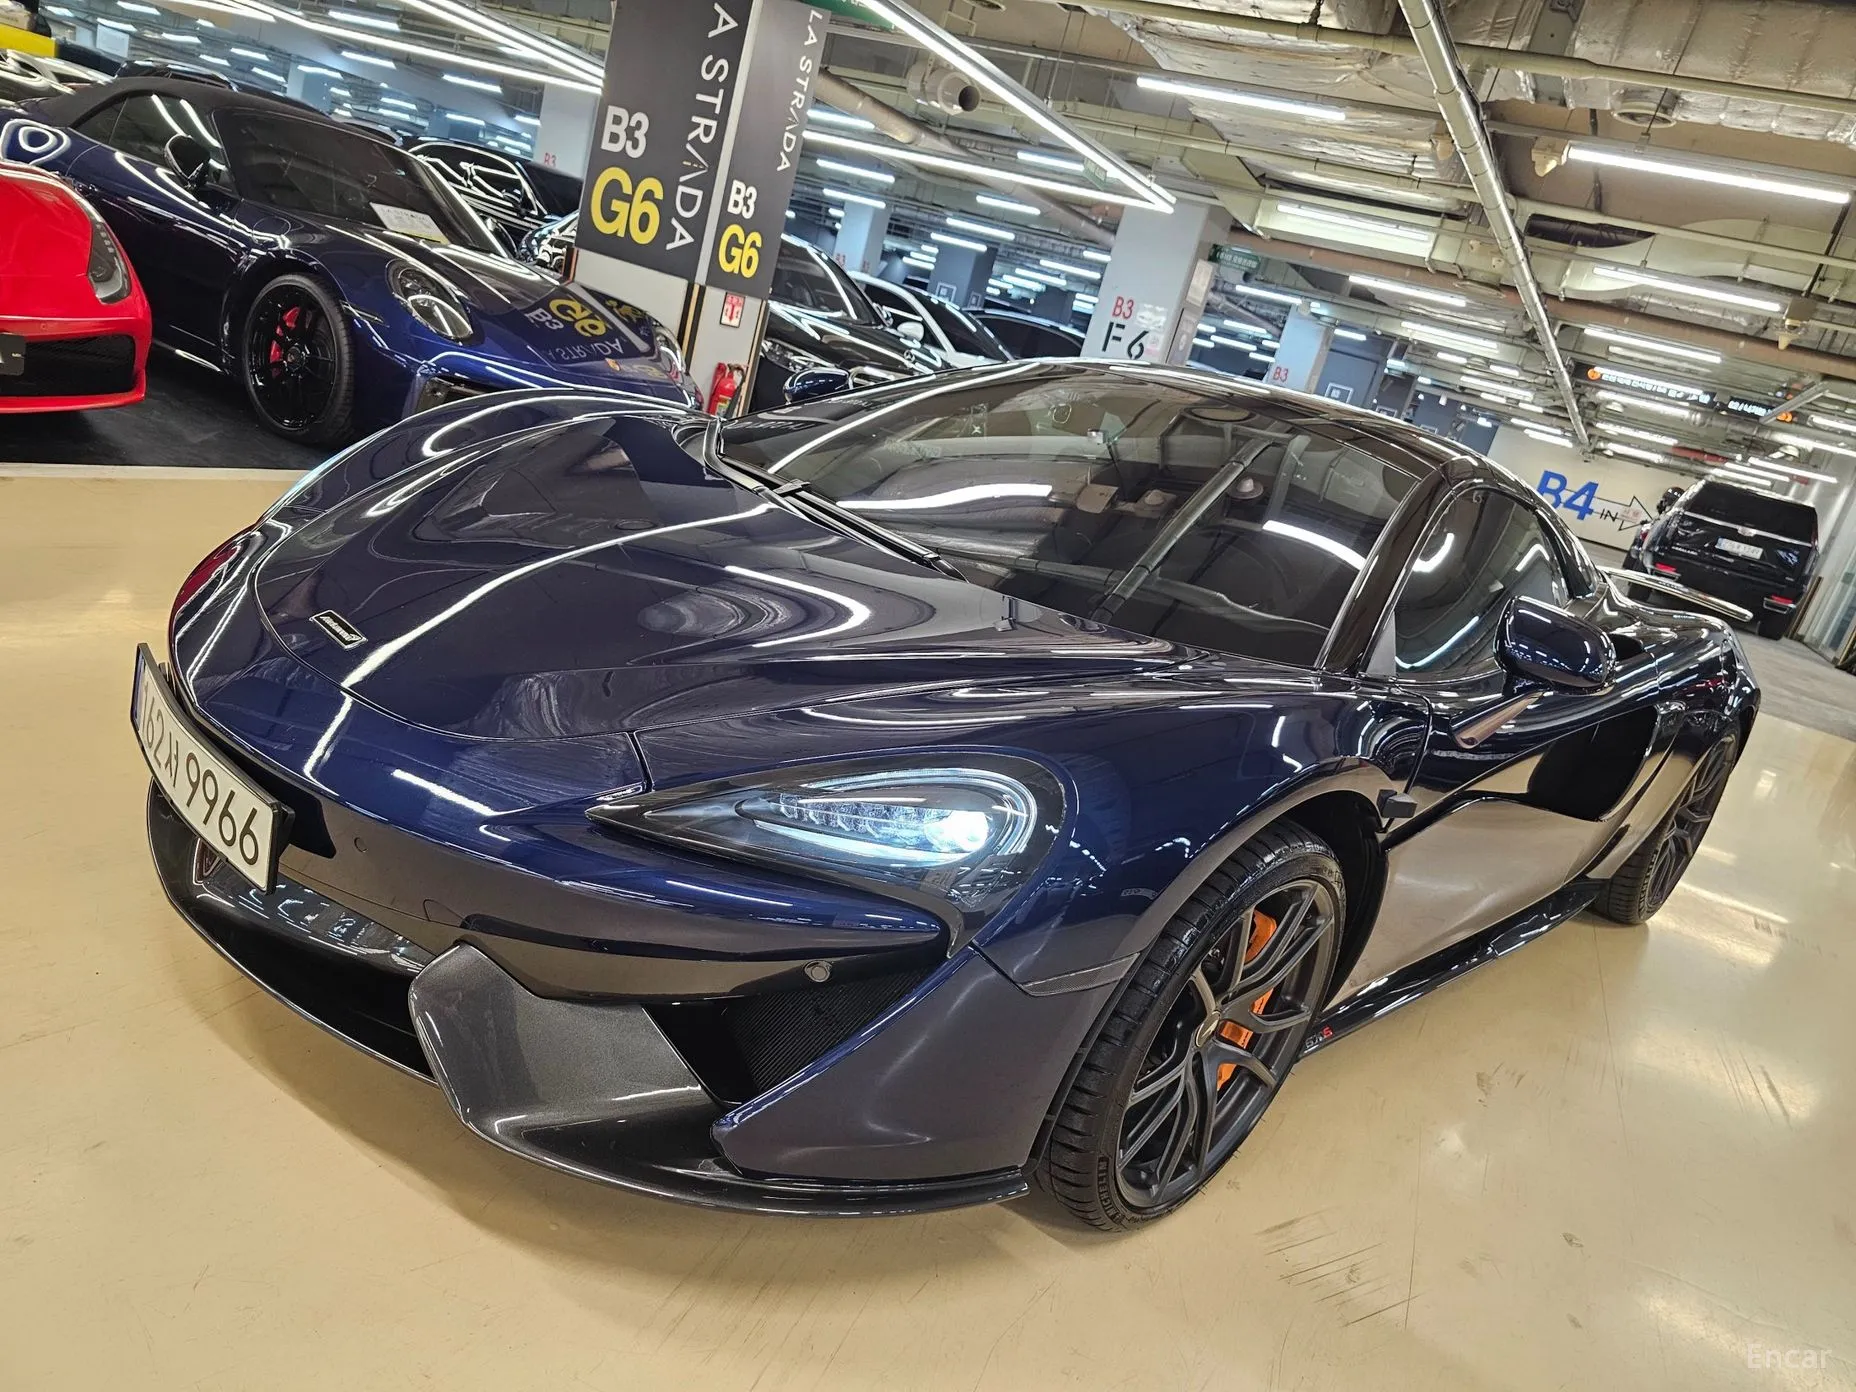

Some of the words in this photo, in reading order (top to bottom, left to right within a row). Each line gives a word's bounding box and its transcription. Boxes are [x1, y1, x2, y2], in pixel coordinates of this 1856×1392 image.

[804, 9, 823, 45] LA
[600, 105, 650, 159] B3
[776, 55, 812, 171] STRADA
[666, 54, 729, 250] STRADA
[591, 166, 664, 245] G6
[727, 179, 757, 219] B3
[718, 224, 762, 278] G6
[1112, 296, 1134, 319] B3
[1273, 366, 1289, 382] B3
[1536, 470, 1598, 520] B4
[1599, 508, 1618, 522] IN
[186, 752, 259, 865] 9966
